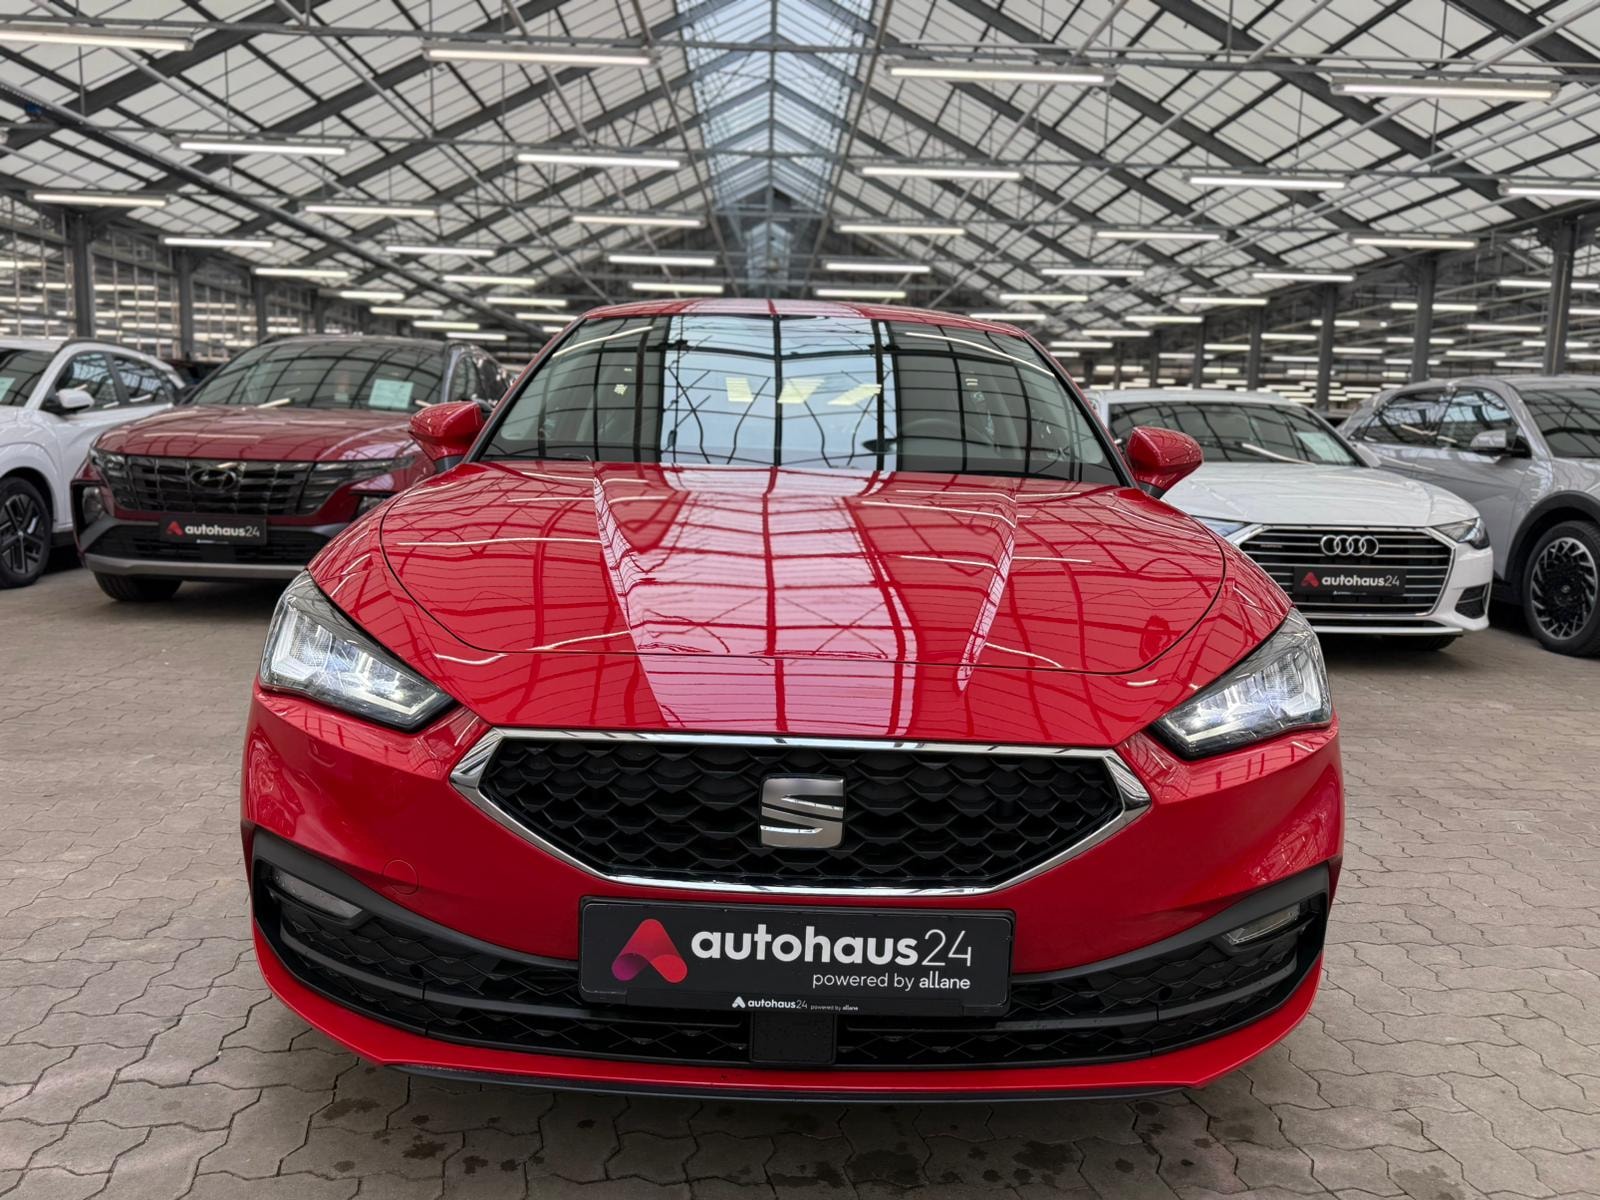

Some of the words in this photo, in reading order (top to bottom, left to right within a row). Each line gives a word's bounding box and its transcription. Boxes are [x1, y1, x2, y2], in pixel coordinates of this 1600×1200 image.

[185, 524, 260, 537] autohaus24
[1321, 574, 1400, 587] autohaus24
[691, 924, 972, 967] autohaus24
[812, 971, 888, 989] powered
[893, 973, 915, 991] by
[919, 971, 971, 989] allane
[747, 999, 808, 1009] autohaus24
